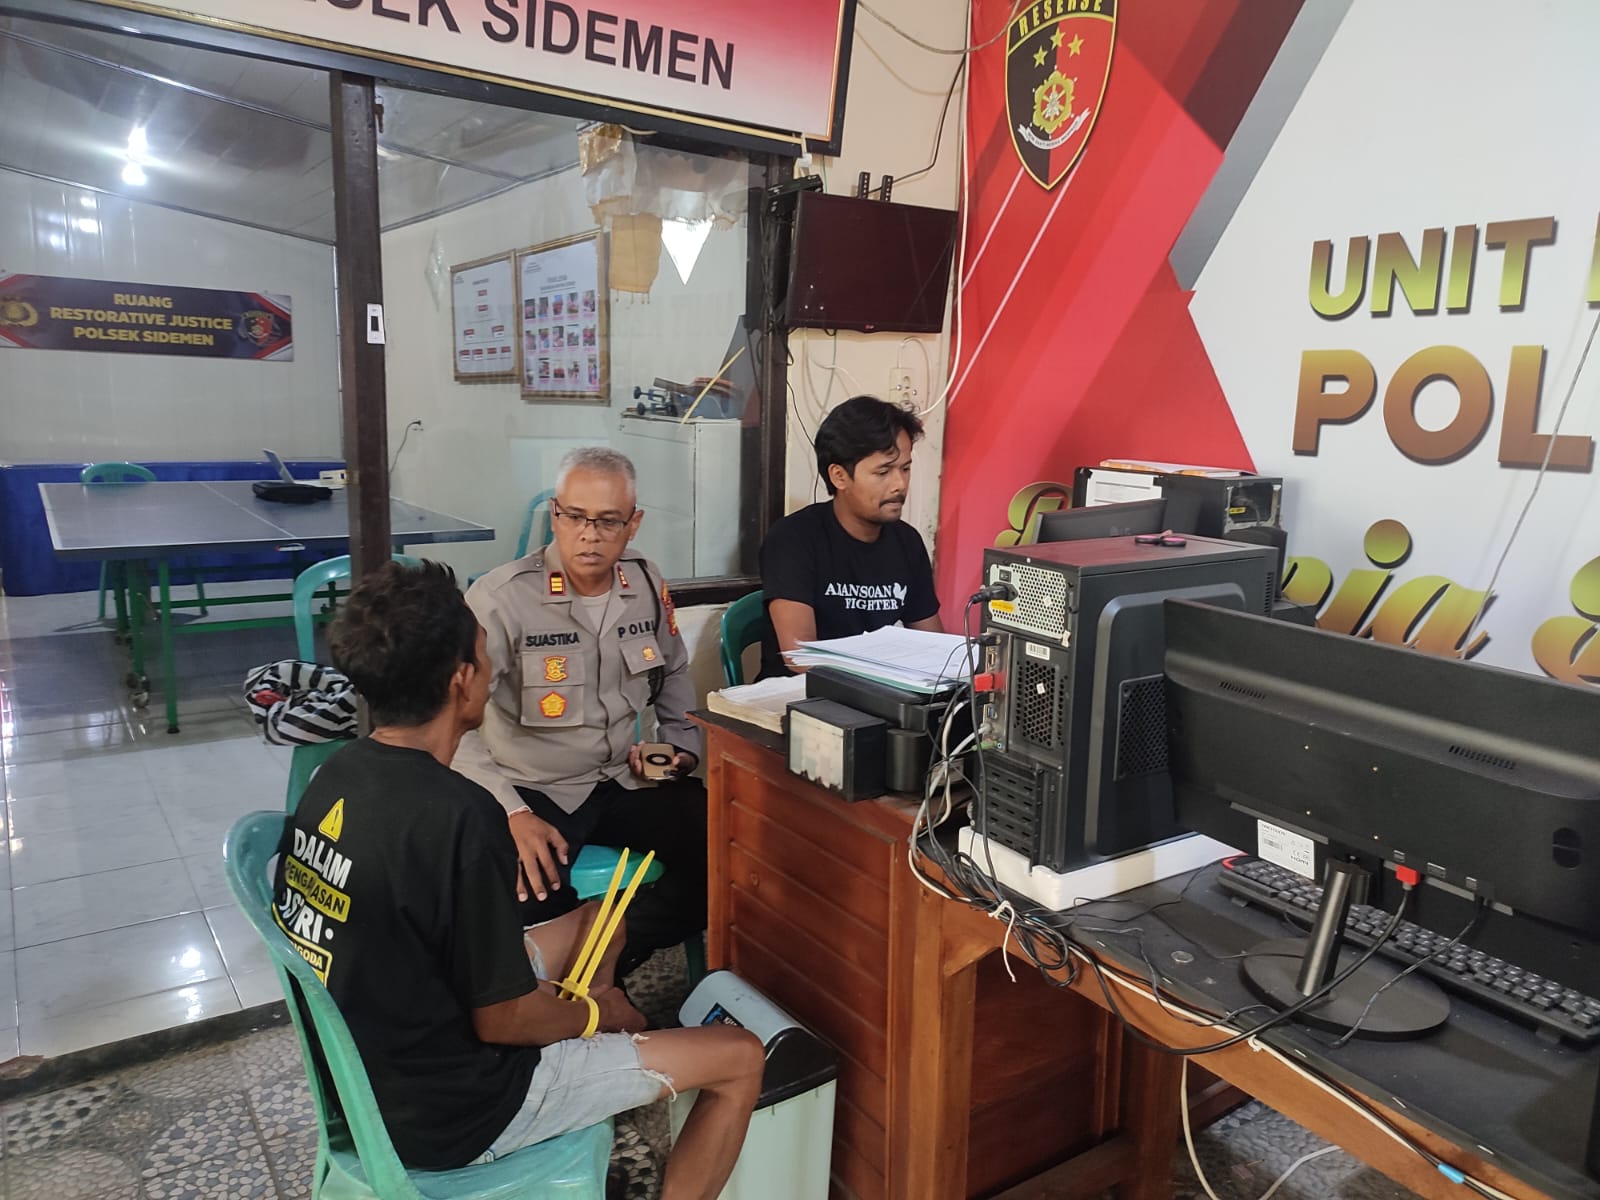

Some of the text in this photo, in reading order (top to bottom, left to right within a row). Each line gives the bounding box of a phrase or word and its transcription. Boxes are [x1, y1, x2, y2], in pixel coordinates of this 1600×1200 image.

[482, 0, 735, 90] SIDEMEN
[1308, 215, 1558, 322] UNIT
[113, 293, 173, 309] RUANG
[51, 306, 233, 331] RESTORATIVE JUSTICE
[73, 326, 214, 346] POLSEK SIDEMEN
[525, 632, 580, 648] SUASTIKA
[293, 828, 353, 889] DALAM
